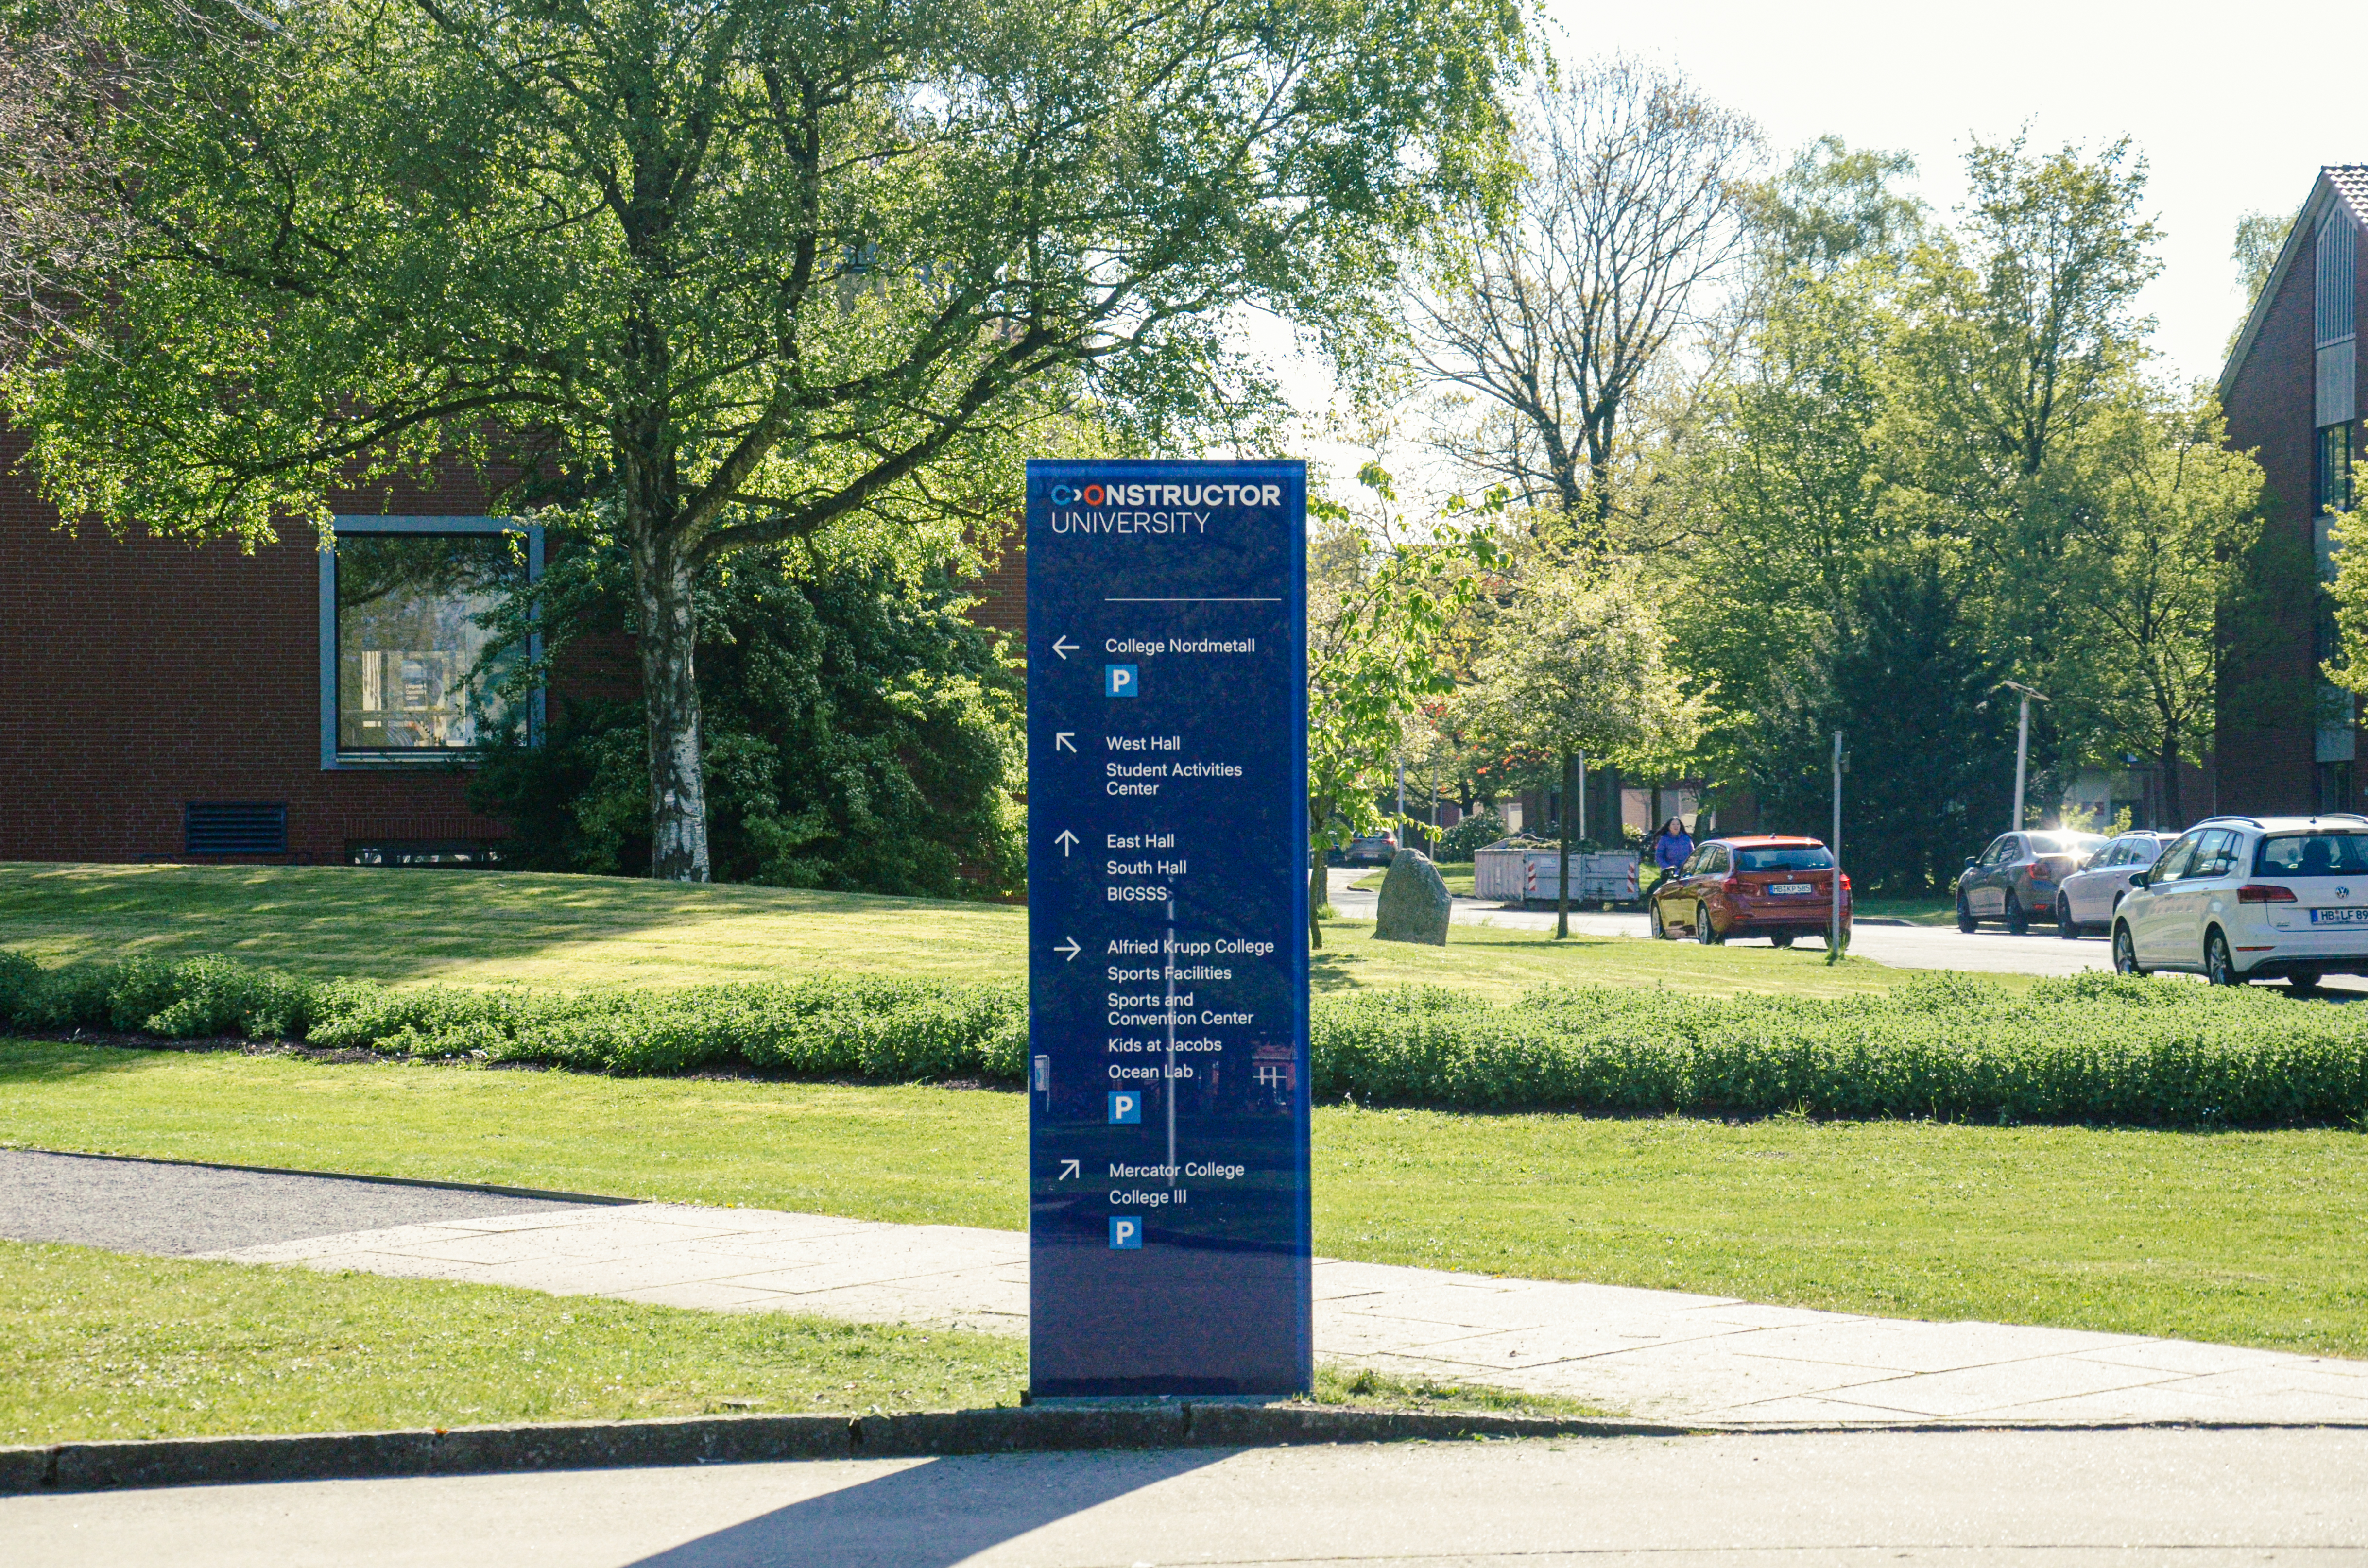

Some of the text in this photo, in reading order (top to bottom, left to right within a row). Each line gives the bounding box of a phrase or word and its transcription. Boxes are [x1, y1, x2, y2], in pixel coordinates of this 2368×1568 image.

[1052, 512, 1210, 533] UNIVERSITY
[1106, 638, 1255, 656] College Nordmetall
[1113, 669, 1130, 692] P
[1106, 736, 1180, 750] West Hall
[1107, 762, 1242, 777] Student Activities
[1106, 781, 1159, 795] Center
[1107, 834, 1174, 848] East Hall
[1107, 860, 1186, 875] South Hall
[1108, 886, 1167, 901] BIGSSS
[2321, 911, 2334, 920] HB
[2340, 910, 2353, 920] LF
[1107, 938, 1274, 956] Alfried Krupp College
[1108, 966, 1232, 984] Sports Facilities
[1108, 992, 1193, 1009] Sports and
[1108, 1010, 1254, 1026] Convention Center
[1109, 1037, 1222, 1052] Kids at Jacobs
[1108, 1064, 1193, 1079] Ocean Lab
[1115, 1096, 1133, 1119] P
[1110, 1162, 1244, 1180] Mercator College
[1110, 1189, 1186, 1207] College III
[1117, 1221, 1134, 1244] P
